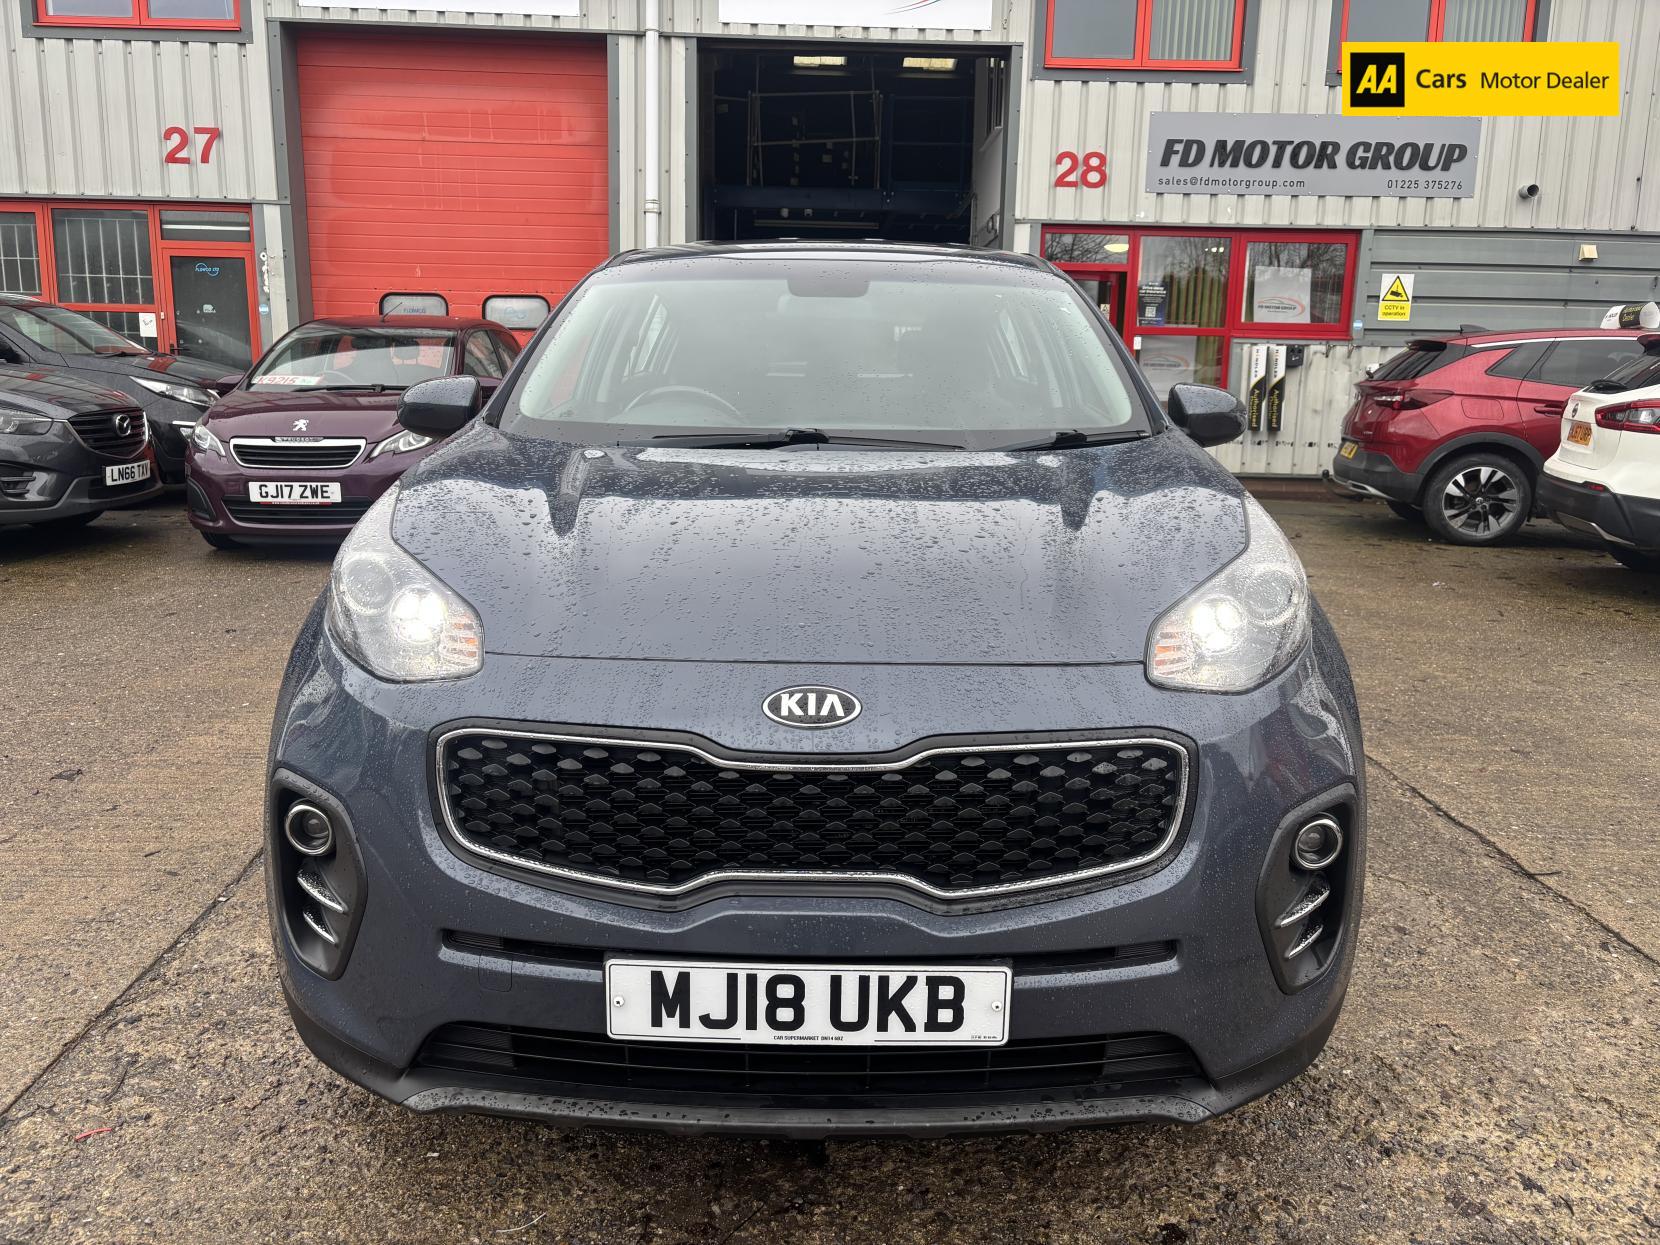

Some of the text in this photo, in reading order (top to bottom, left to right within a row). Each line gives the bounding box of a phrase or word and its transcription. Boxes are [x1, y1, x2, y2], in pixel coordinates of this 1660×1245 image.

[163, 126, 220, 165] 27
[1160, 138, 1468, 172] FD MOTOR GROUP
[1054, 150, 1107, 189] 28
[1157, 176, 1306, 189] sales@fdmotorgroup.com
[1387, 178, 1463, 190] 01225 375276
[111, 466, 135, 482] LN66
[258, 484, 331, 499] GJ17 ZWE
[780, 692, 845, 717] KIA
[650, 970, 966, 1033] MJ18 UKB
